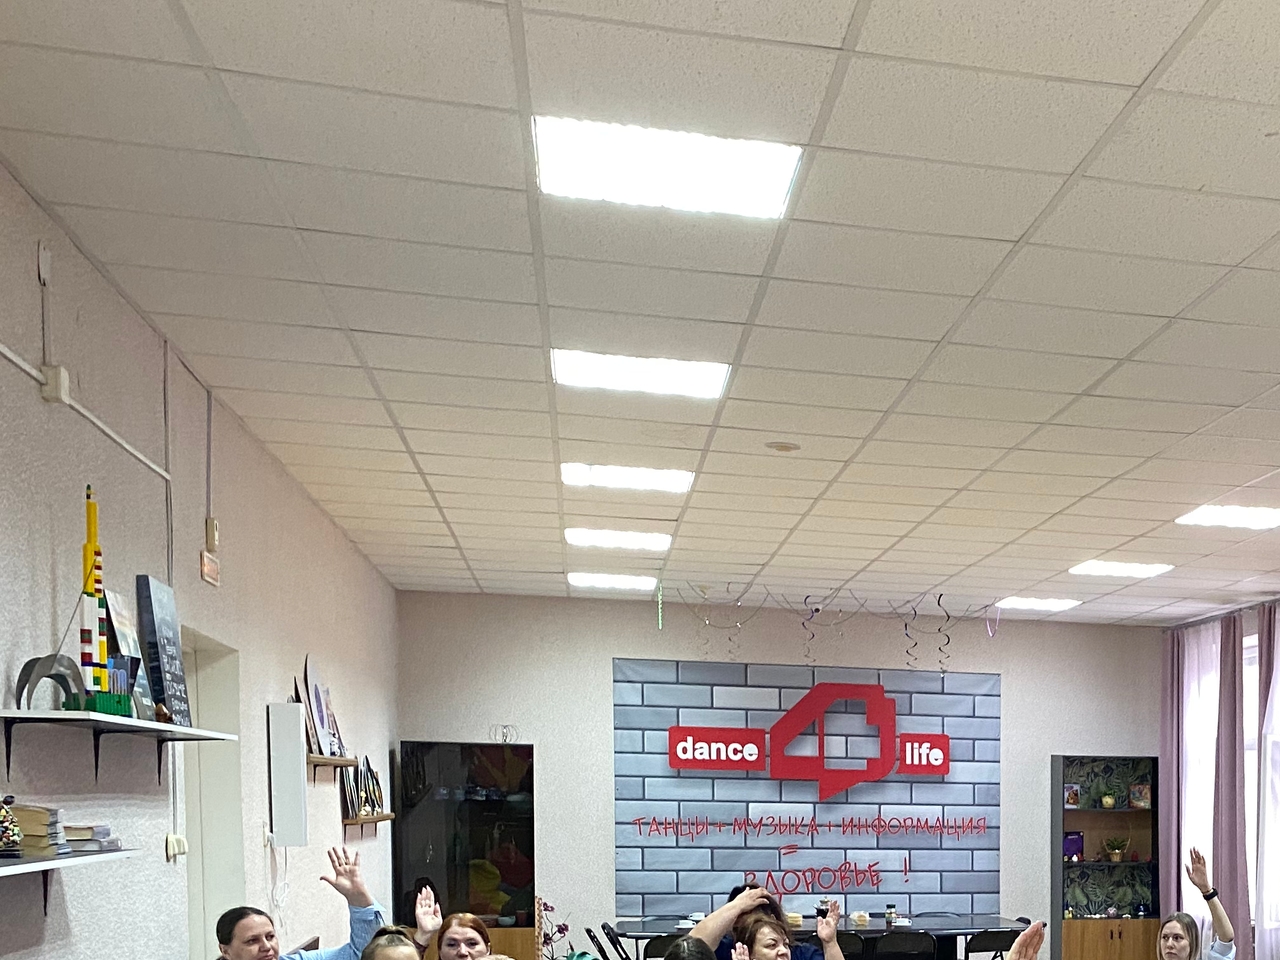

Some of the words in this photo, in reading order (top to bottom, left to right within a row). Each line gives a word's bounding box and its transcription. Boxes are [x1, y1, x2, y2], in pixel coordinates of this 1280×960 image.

[676, 736, 759, 762] dance
[905, 742, 944, 766] life
[632, 815, 709, 843] ТАНЦЫ
[732, 815, 820, 838] МУЗЫКА
[842, 814, 987, 841] ИНФОРМАЦИЯ
